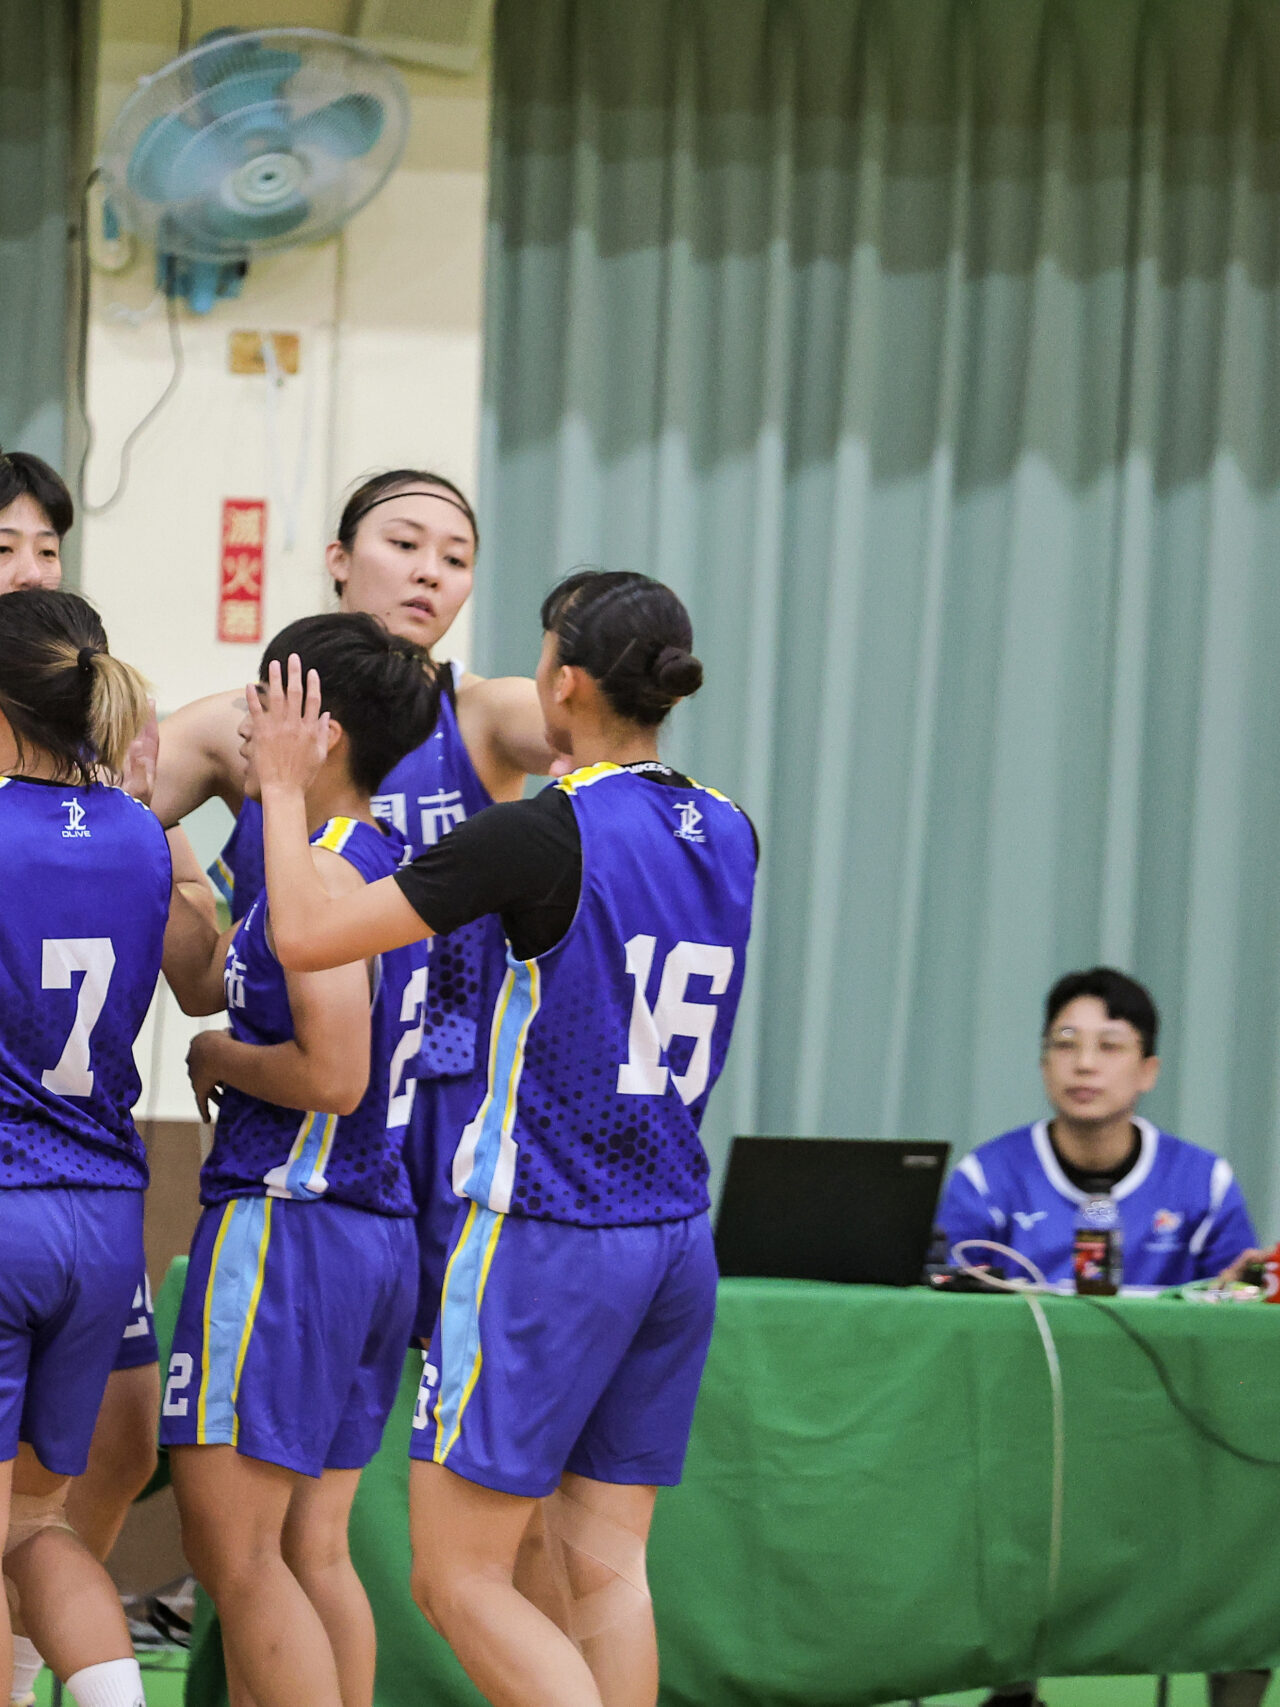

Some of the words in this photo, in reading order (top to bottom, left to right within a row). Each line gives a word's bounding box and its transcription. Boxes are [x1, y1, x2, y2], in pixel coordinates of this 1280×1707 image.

[61, 830, 92, 838] OLIVE
[41, 937, 116, 1097] 7
[616, 934, 735, 1106] 16
[162, 1352, 194, 1416] 2
